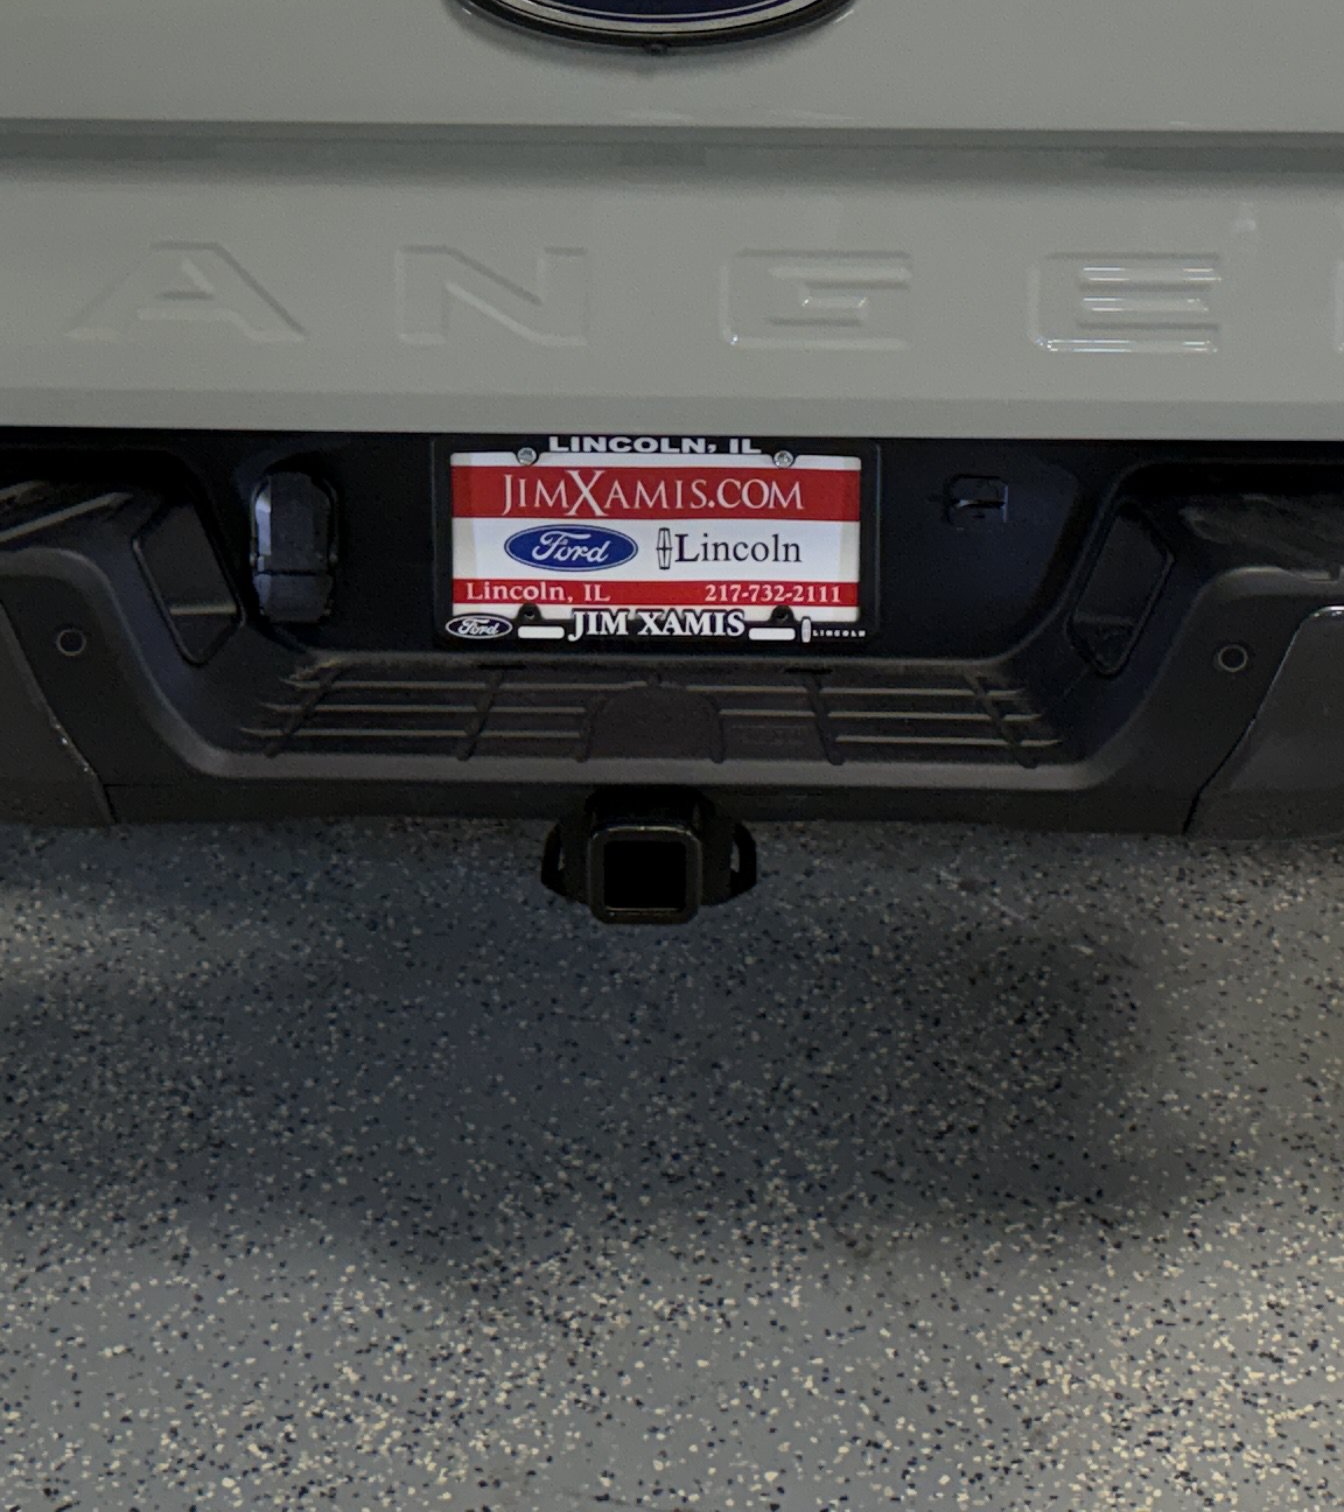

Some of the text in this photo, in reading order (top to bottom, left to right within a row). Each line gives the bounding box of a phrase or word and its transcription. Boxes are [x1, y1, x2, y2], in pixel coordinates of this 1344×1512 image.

[548, 436, 762, 455] LINCOLN, IL
[502, 470, 805, 516] JIMXAMIS.COM
[531, 531, 803, 564] Ford Lincoln
[466, 581, 611, 603] Lincoln, IL
[705, 584, 842, 604] 217-732-2111
[457, 618, 499, 635] Ford
[567, 610, 745, 642] JIM XAMIS
